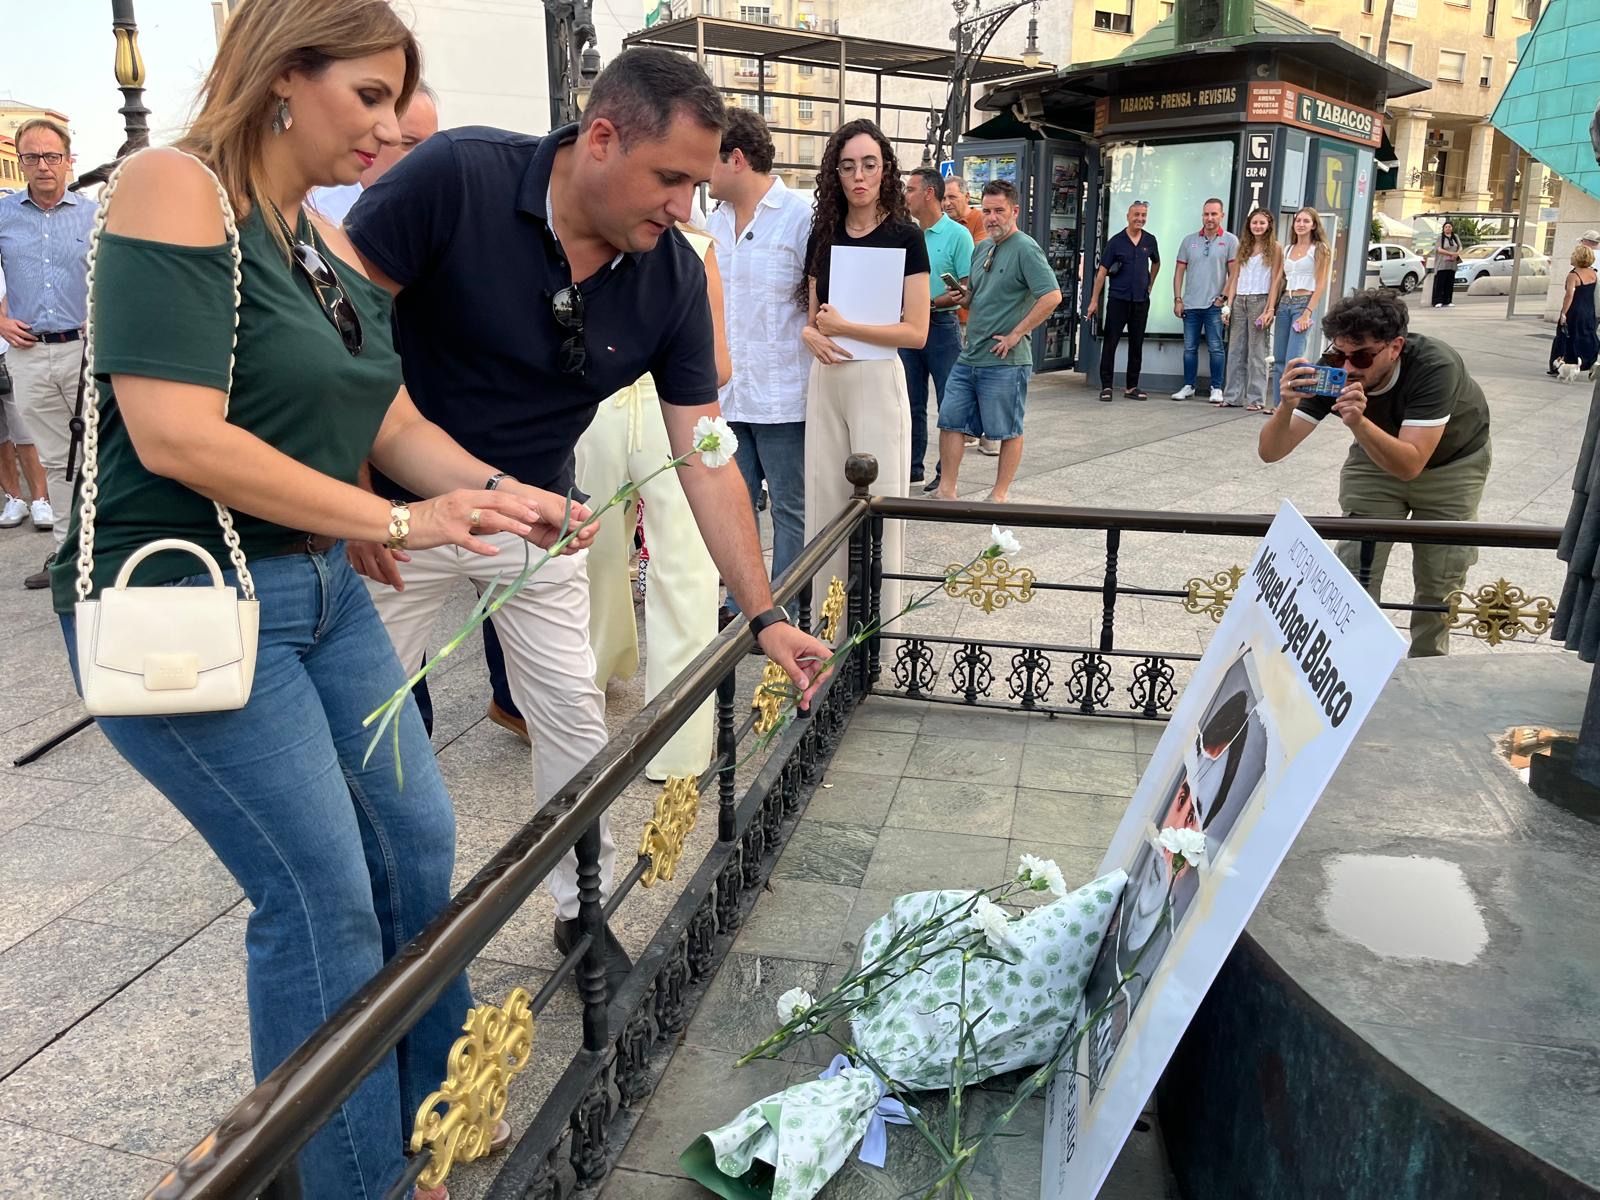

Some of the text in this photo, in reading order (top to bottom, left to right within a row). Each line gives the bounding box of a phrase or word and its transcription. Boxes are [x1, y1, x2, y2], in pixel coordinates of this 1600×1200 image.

[1120, 96, 1154, 113] TABACOS
[1161, 92, 1191, 109] PRENSA
[1199, 87, 1237, 106] REVISTAS
[1316, 100, 1372, 132] TABACOS
[1245, 167, 1267, 178] EXP. 40
[1288, 538, 1356, 635] ACTO EN MEMORIA DE
[1252, 545, 1353, 728] Miguel Ángel Blanco
[1066, 1103, 1076, 1163] JULIO
